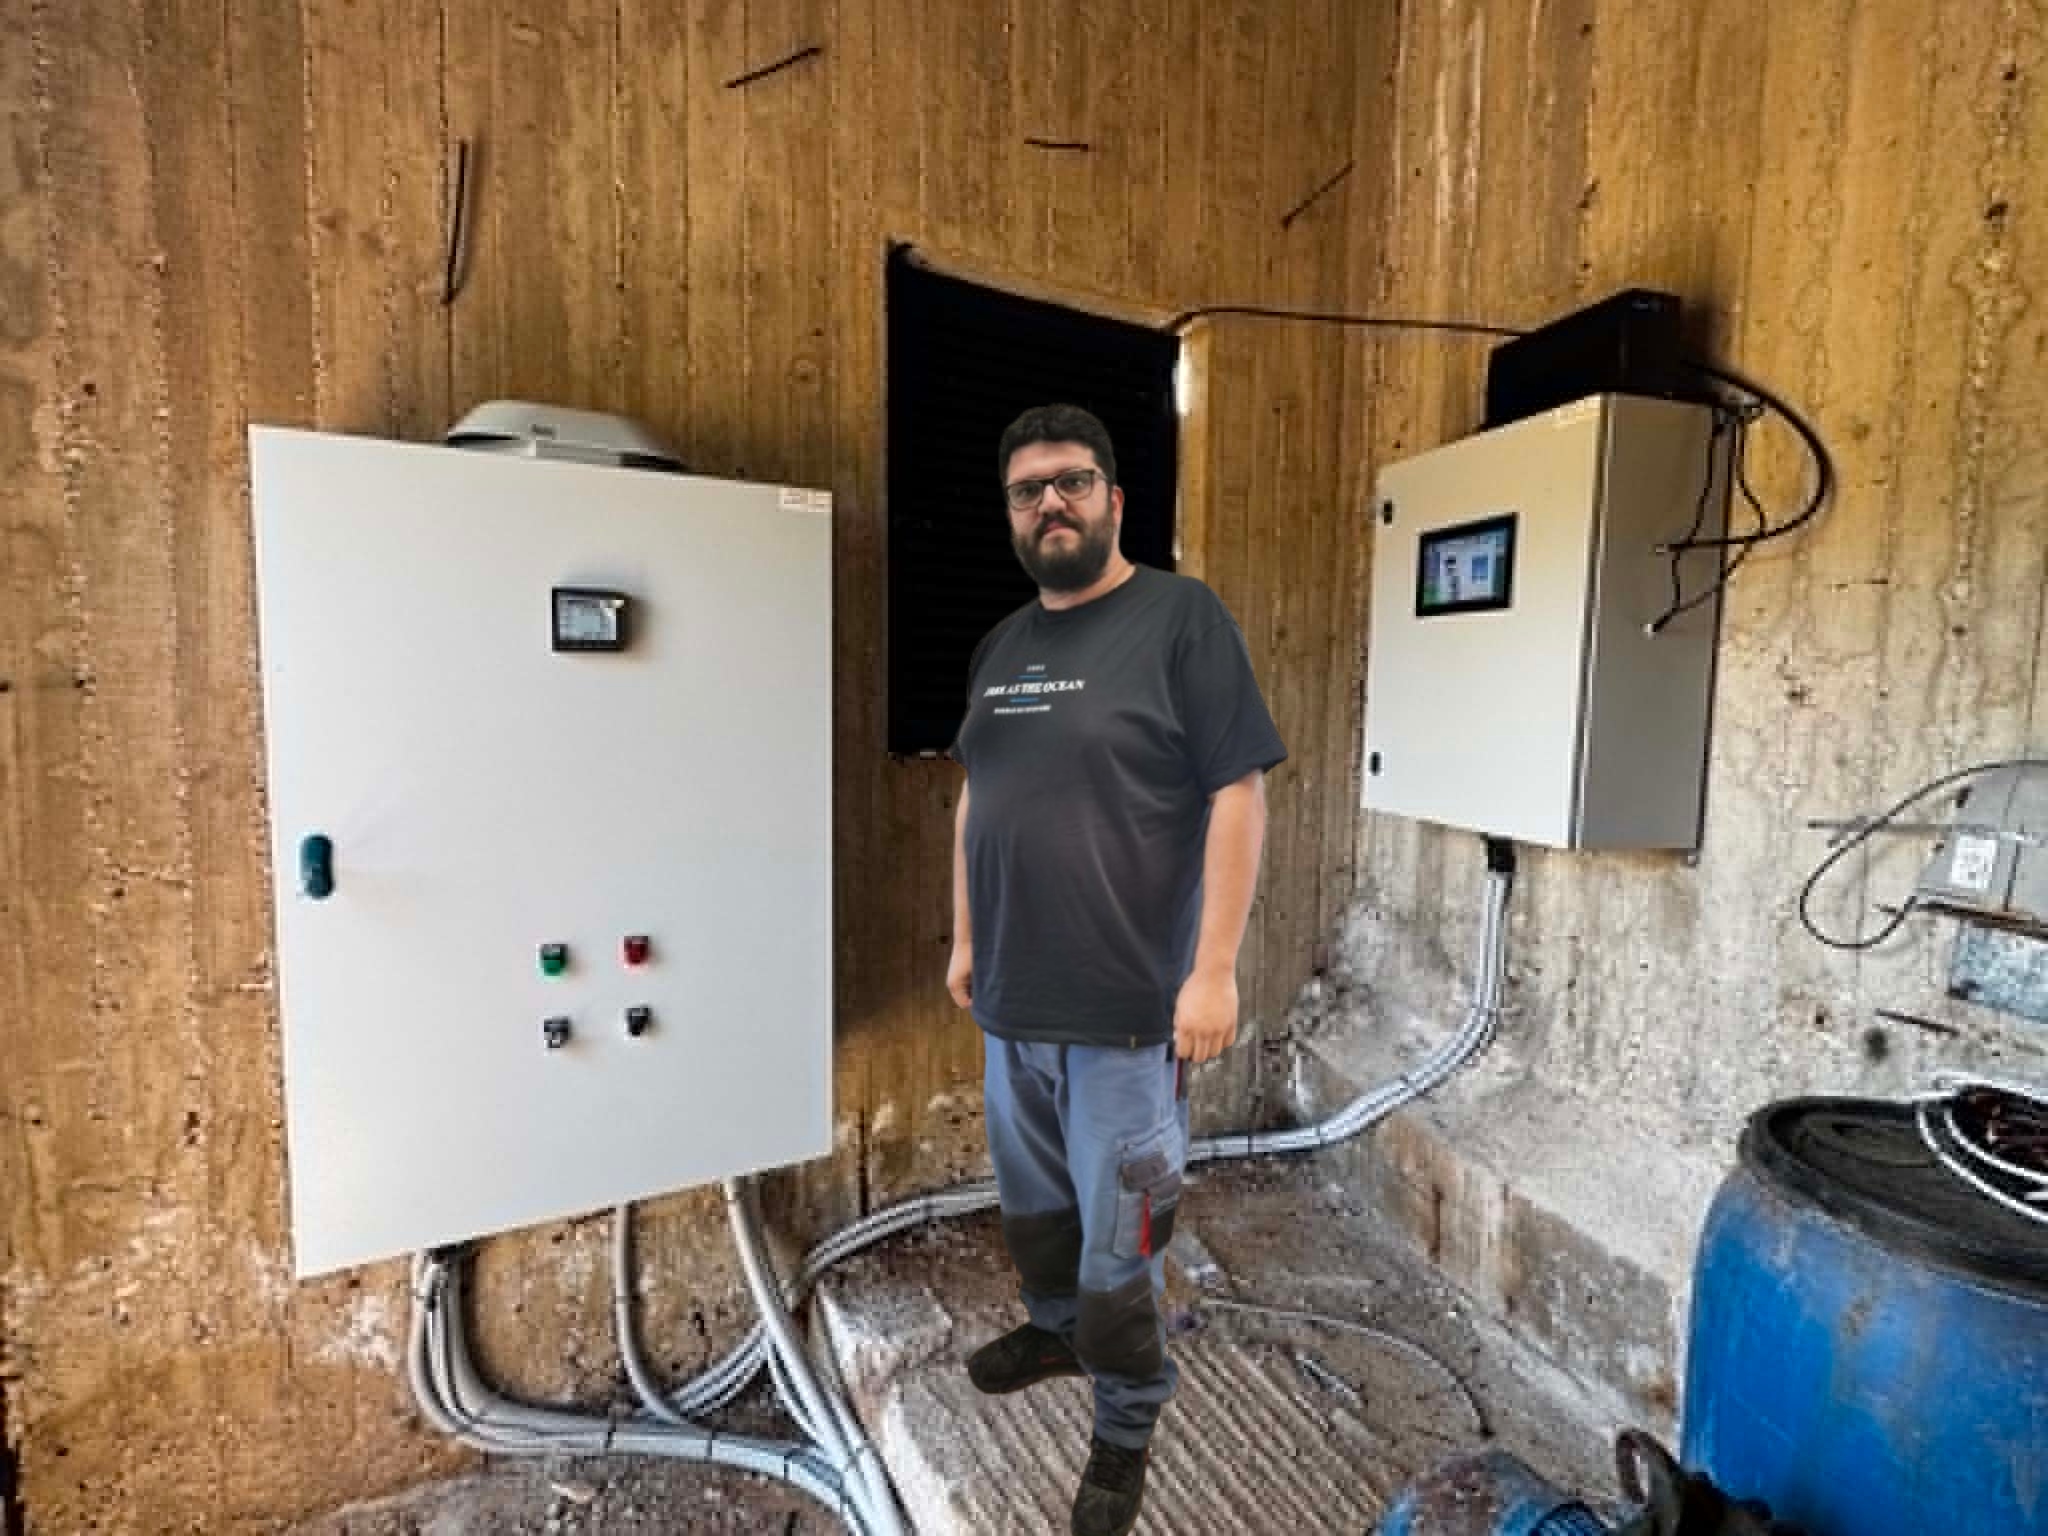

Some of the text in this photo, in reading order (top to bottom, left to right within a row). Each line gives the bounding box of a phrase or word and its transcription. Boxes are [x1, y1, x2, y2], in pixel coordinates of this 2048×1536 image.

[1006, 684, 1020, 695] AS
[1021, 682, 1042, 694] THE
[1043, 680, 1086, 693] OCEAN
